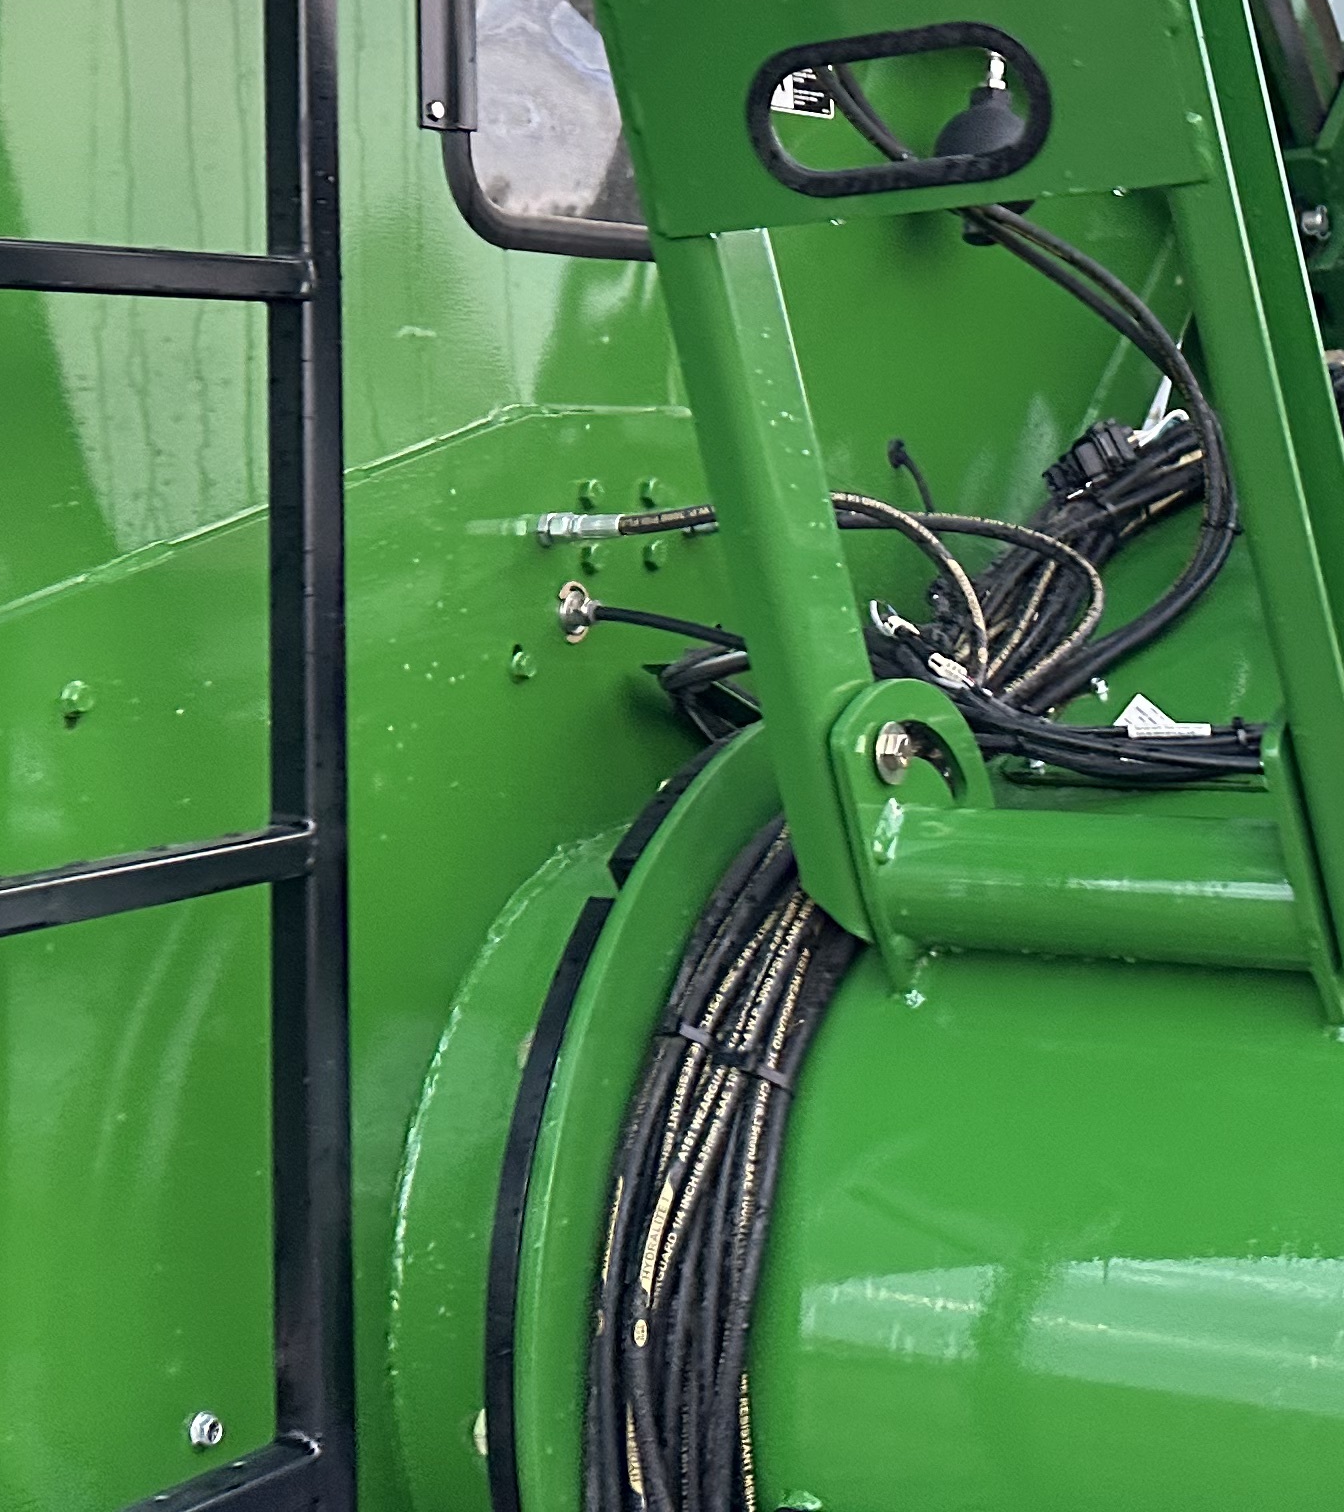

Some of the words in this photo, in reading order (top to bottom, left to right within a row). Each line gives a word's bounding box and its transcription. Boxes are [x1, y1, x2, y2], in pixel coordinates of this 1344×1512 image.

[771, 975, 805, 1051] WEARGUARD
[667, 1056, 695, 1128] RESISTANT
[679, 1175, 700, 1210] INCH
[715, 1090, 733, 1118] SAE
[756, 977, 775, 1005] 3000
[768, 956, 784, 978] PSI
[777, 918, 805, 957] FLAME
[641, 1204, 668, 1281] HYDRALITE
